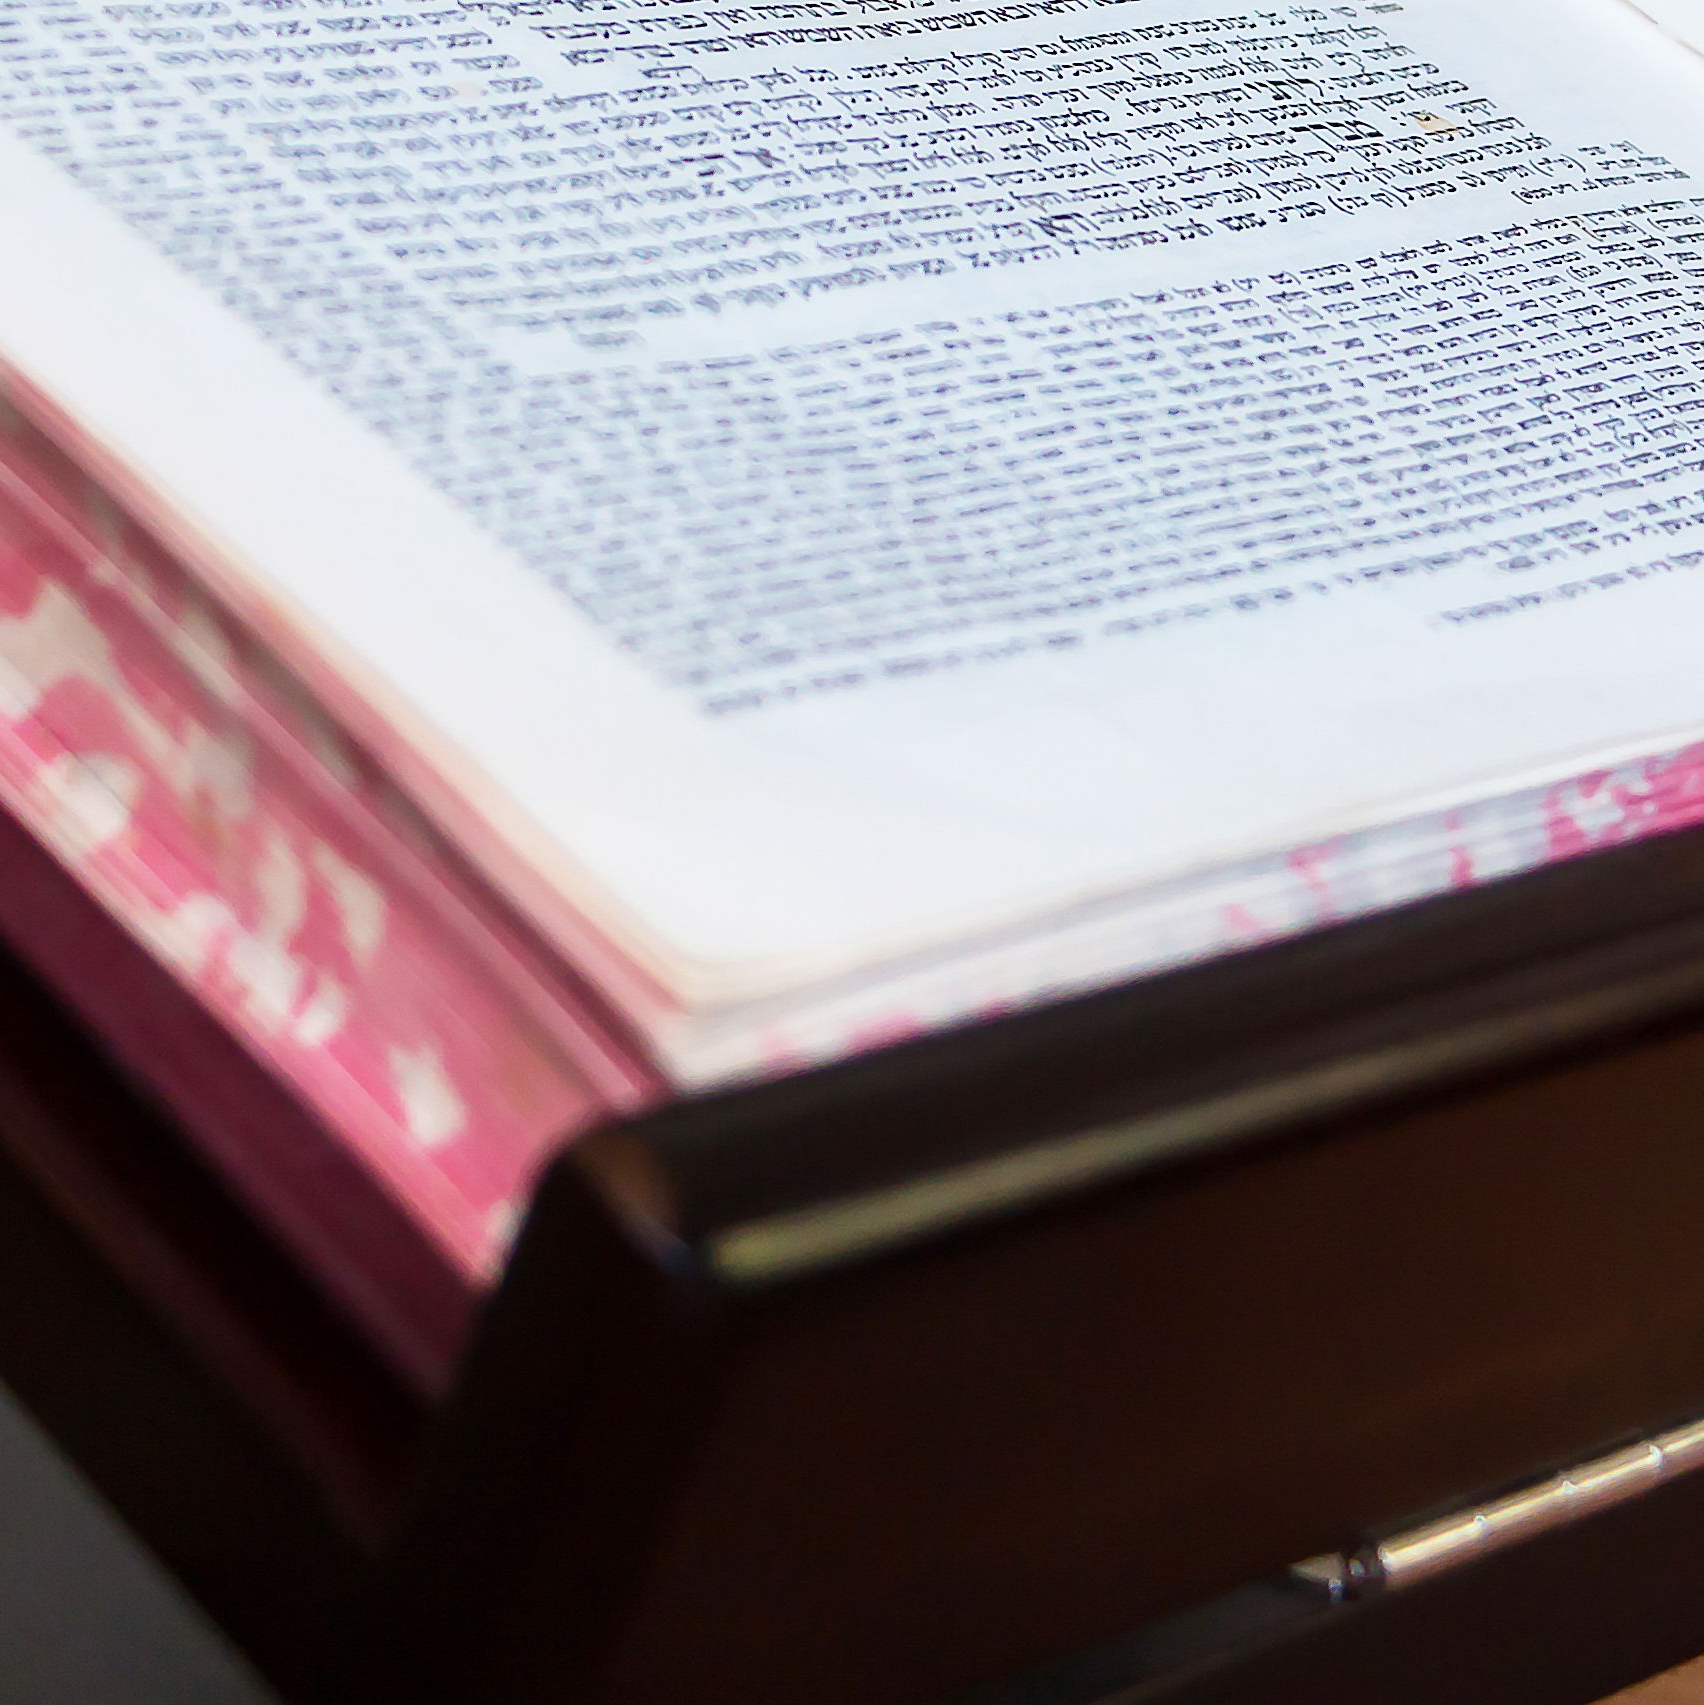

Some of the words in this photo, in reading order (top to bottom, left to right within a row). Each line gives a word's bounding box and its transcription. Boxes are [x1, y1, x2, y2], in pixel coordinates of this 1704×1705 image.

[703, 8, 756, 31] ואין
[749, 1, 848, 20] בתרומה
[1289, 119, 1385, 153] מברך
